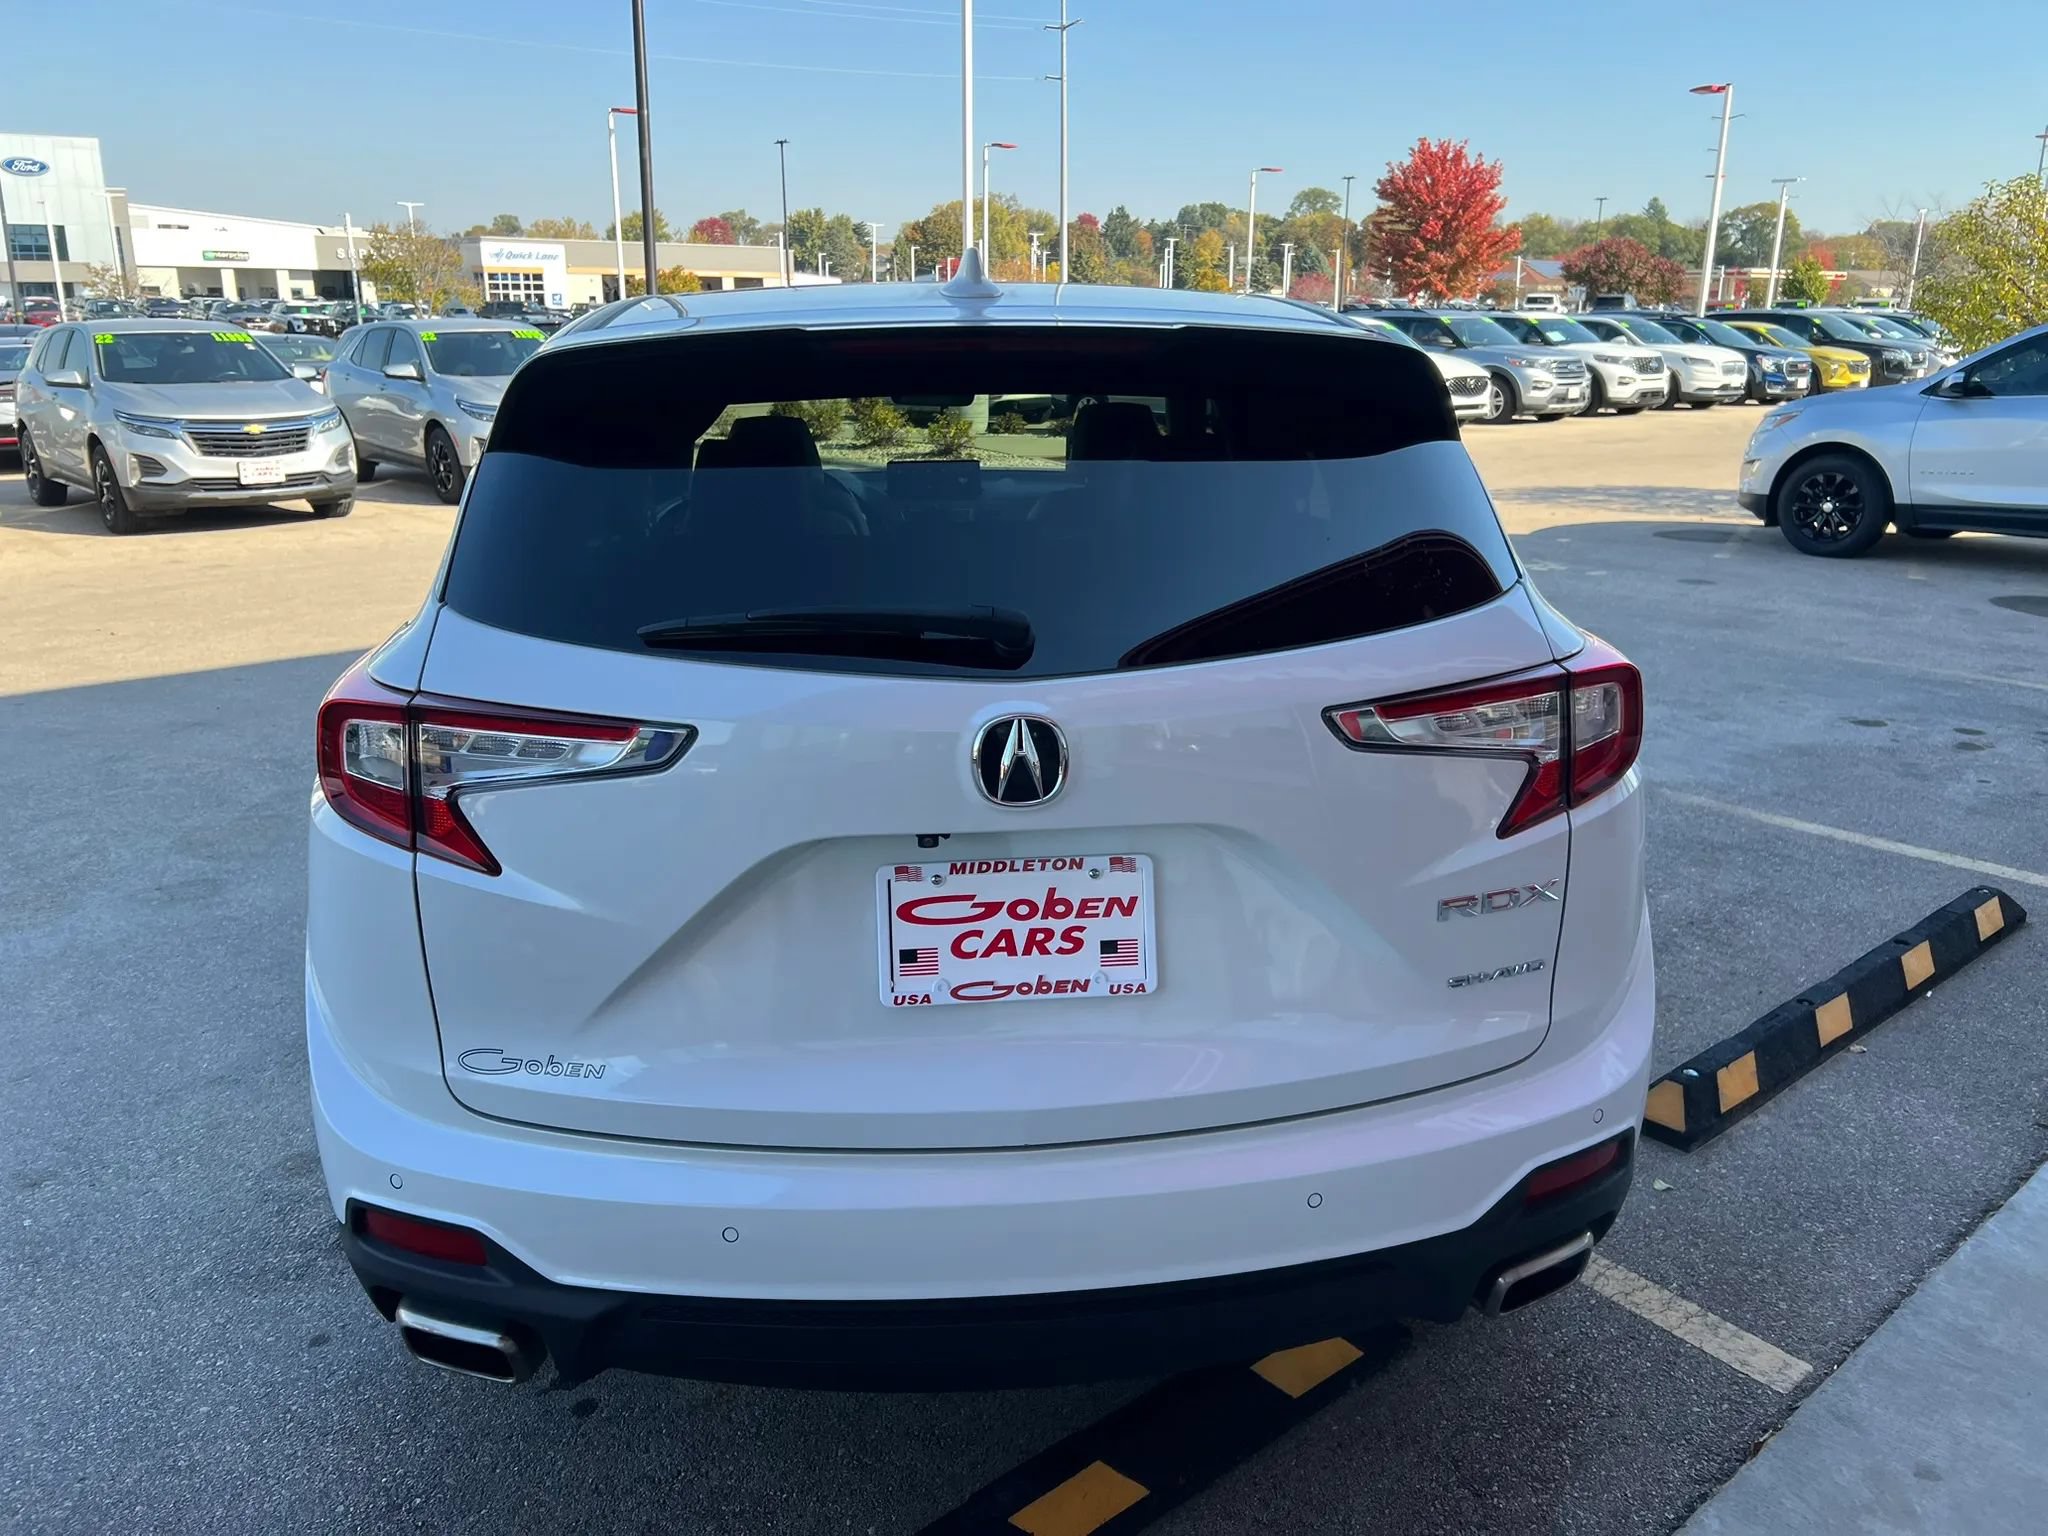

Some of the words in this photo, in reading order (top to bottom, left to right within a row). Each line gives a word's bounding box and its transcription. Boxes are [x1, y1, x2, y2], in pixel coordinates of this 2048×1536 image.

[505, 251, 533, 260] Quick
[535, 252, 559, 260] Lane
[95, 334, 114, 344] 22
[949, 857, 1084, 875] MIDDLETON
[1437, 878, 1560, 922] RDX
[950, 925, 1087, 960] CARS
[1108, 982, 1147, 995] USA
[893, 993, 932, 1006] USA
